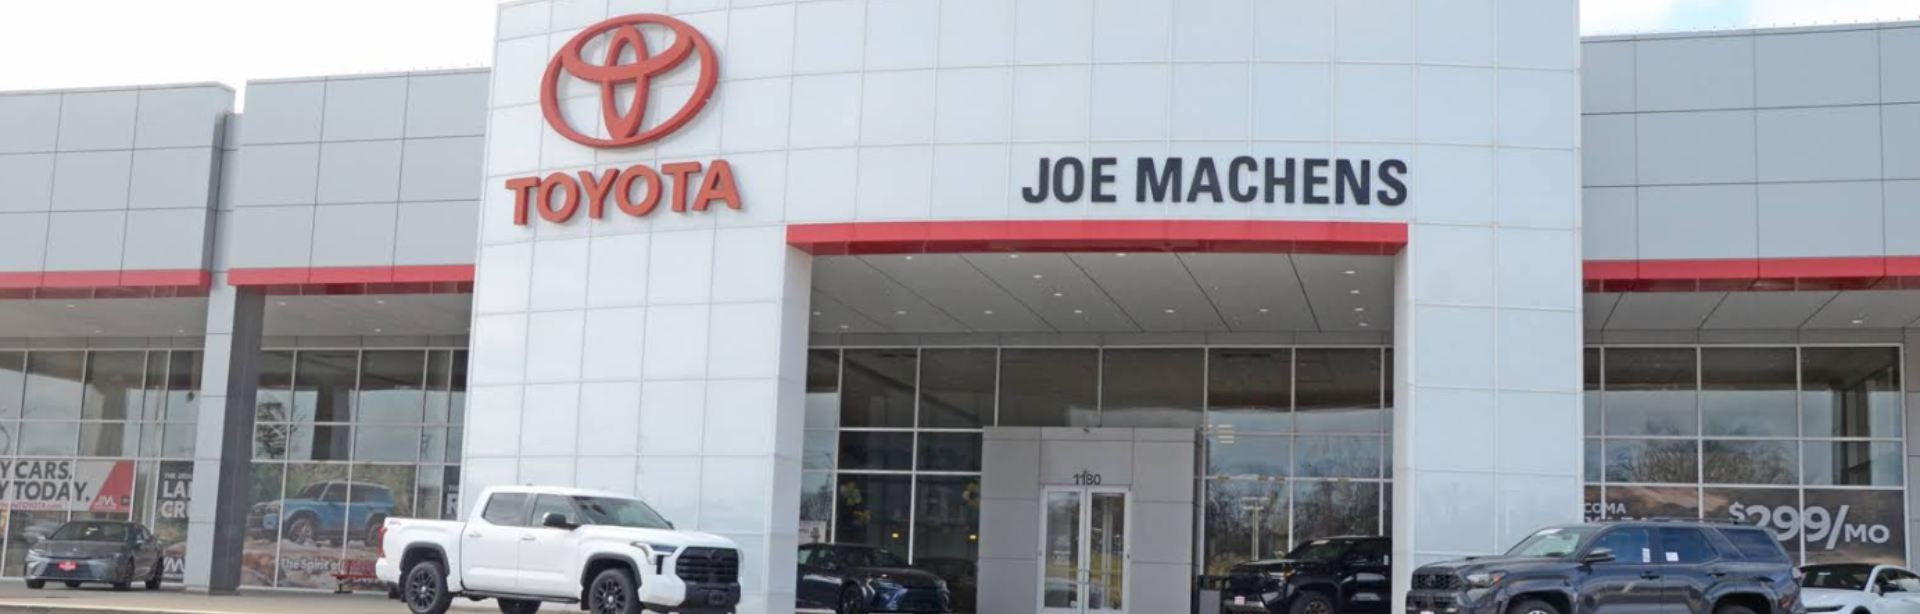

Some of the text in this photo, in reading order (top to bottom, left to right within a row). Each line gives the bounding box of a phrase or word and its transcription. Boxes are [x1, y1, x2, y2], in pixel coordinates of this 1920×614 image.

[1021, 155, 1408, 207] JOE MACHENS
[505, 159, 742, 226] TOYOTA
[1072, 473, 1102, 486] 1180
[13, 481, 91, 501] TODAY.
[281, 559, 299, 570] The
[301, 559, 329, 573] Spirit
